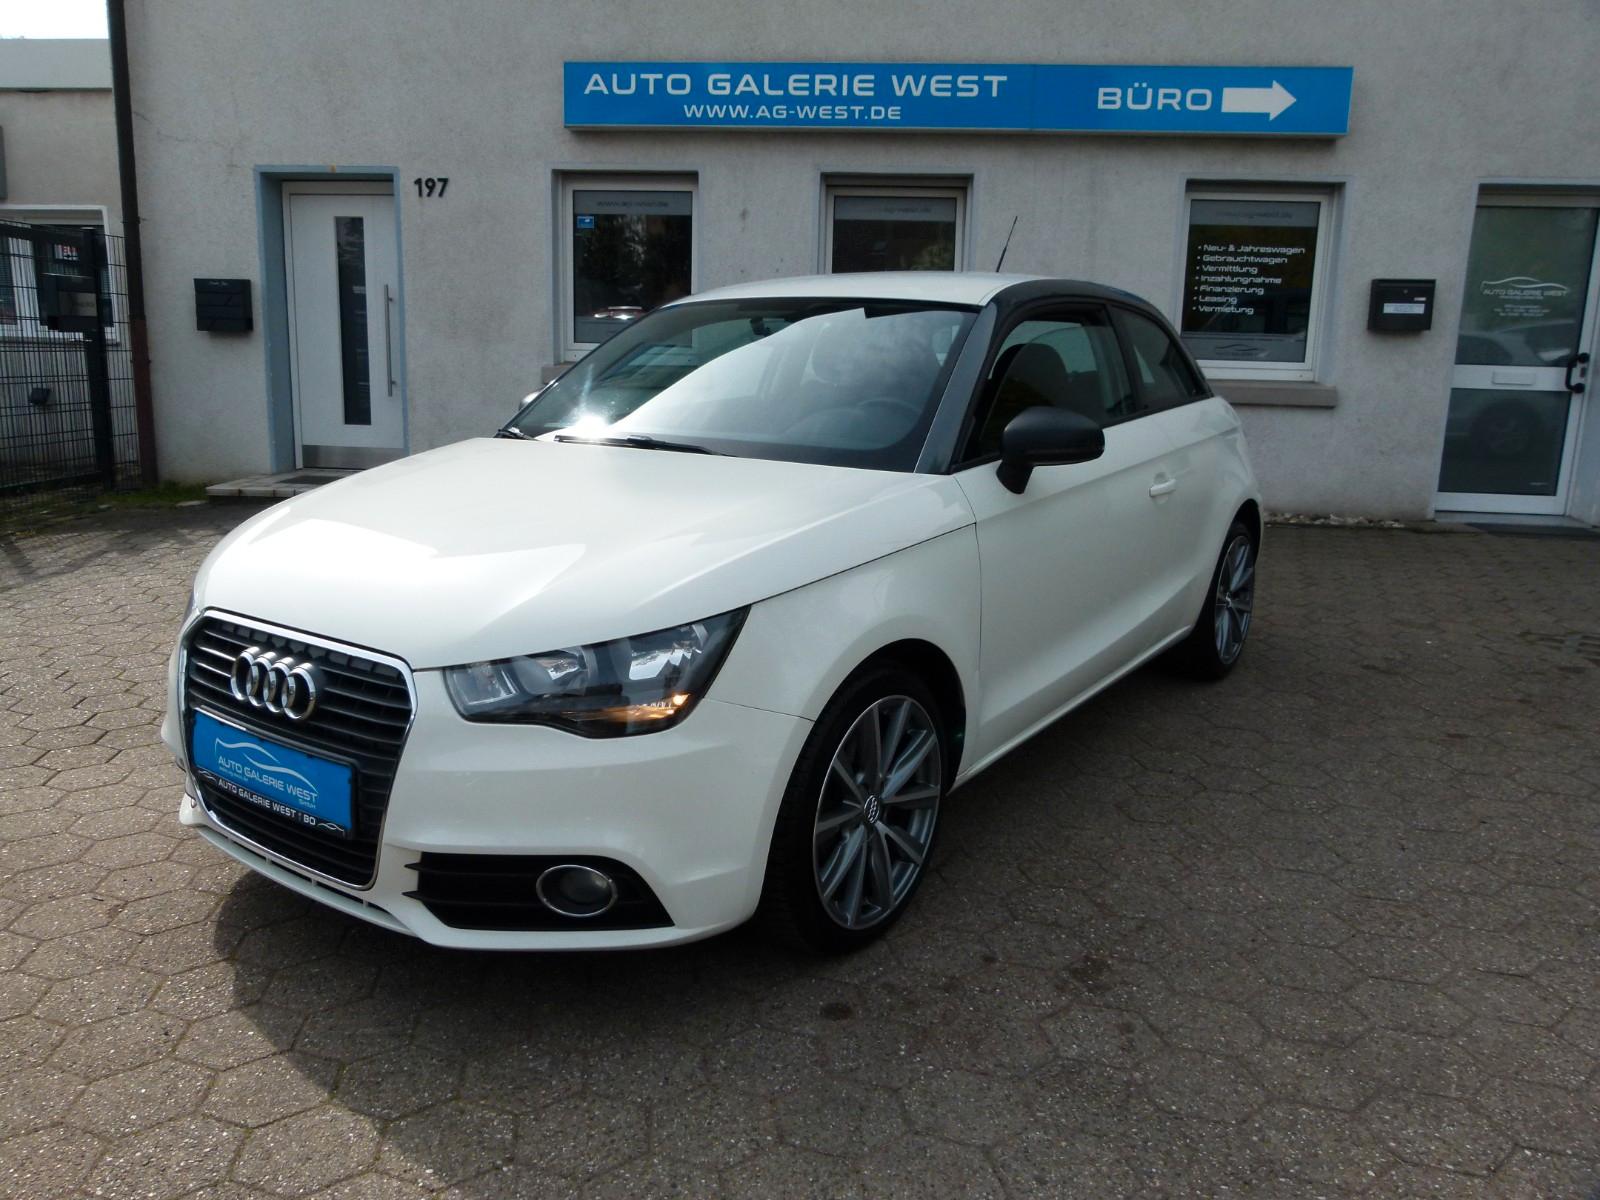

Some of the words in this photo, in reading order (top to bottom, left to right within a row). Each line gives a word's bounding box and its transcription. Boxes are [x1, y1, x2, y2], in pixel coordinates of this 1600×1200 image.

[584, 73, 691, 95] AUTO
[707, 74, 875, 96] GALERIE
[891, 75, 1008, 97] WEST
[1097, 82, 1213, 111] BÜRO
[684, 104, 902, 120] WWW.AG-WEST.DE
[414, 177, 449, 198] 197
[1203, 244, 1226, 252] Neu-
[1228, 244, 1235, 252] &
[1237, 245, 1305, 255] Jahreswagen
[1202, 254, 1288, 265] Gebrauchtwagen
[1202, 265, 1258, 275] Vermittlung
[1200, 275, 1282, 285] Inzahlungnahme
[1199, 285, 1264, 296] Finanzierung
[1198, 295, 1238, 305] Leasing
[1198, 305, 1254, 316] Vermietung
[218, 755, 242, 774] AUTO
[244, 767, 284, 791] GALERIE
[286, 783, 318, 803] WEST
[218, 779, 238, 794] AUTO
[238, 788, 271, 809] GALERIE
[272, 802, 297, 818] WEST
